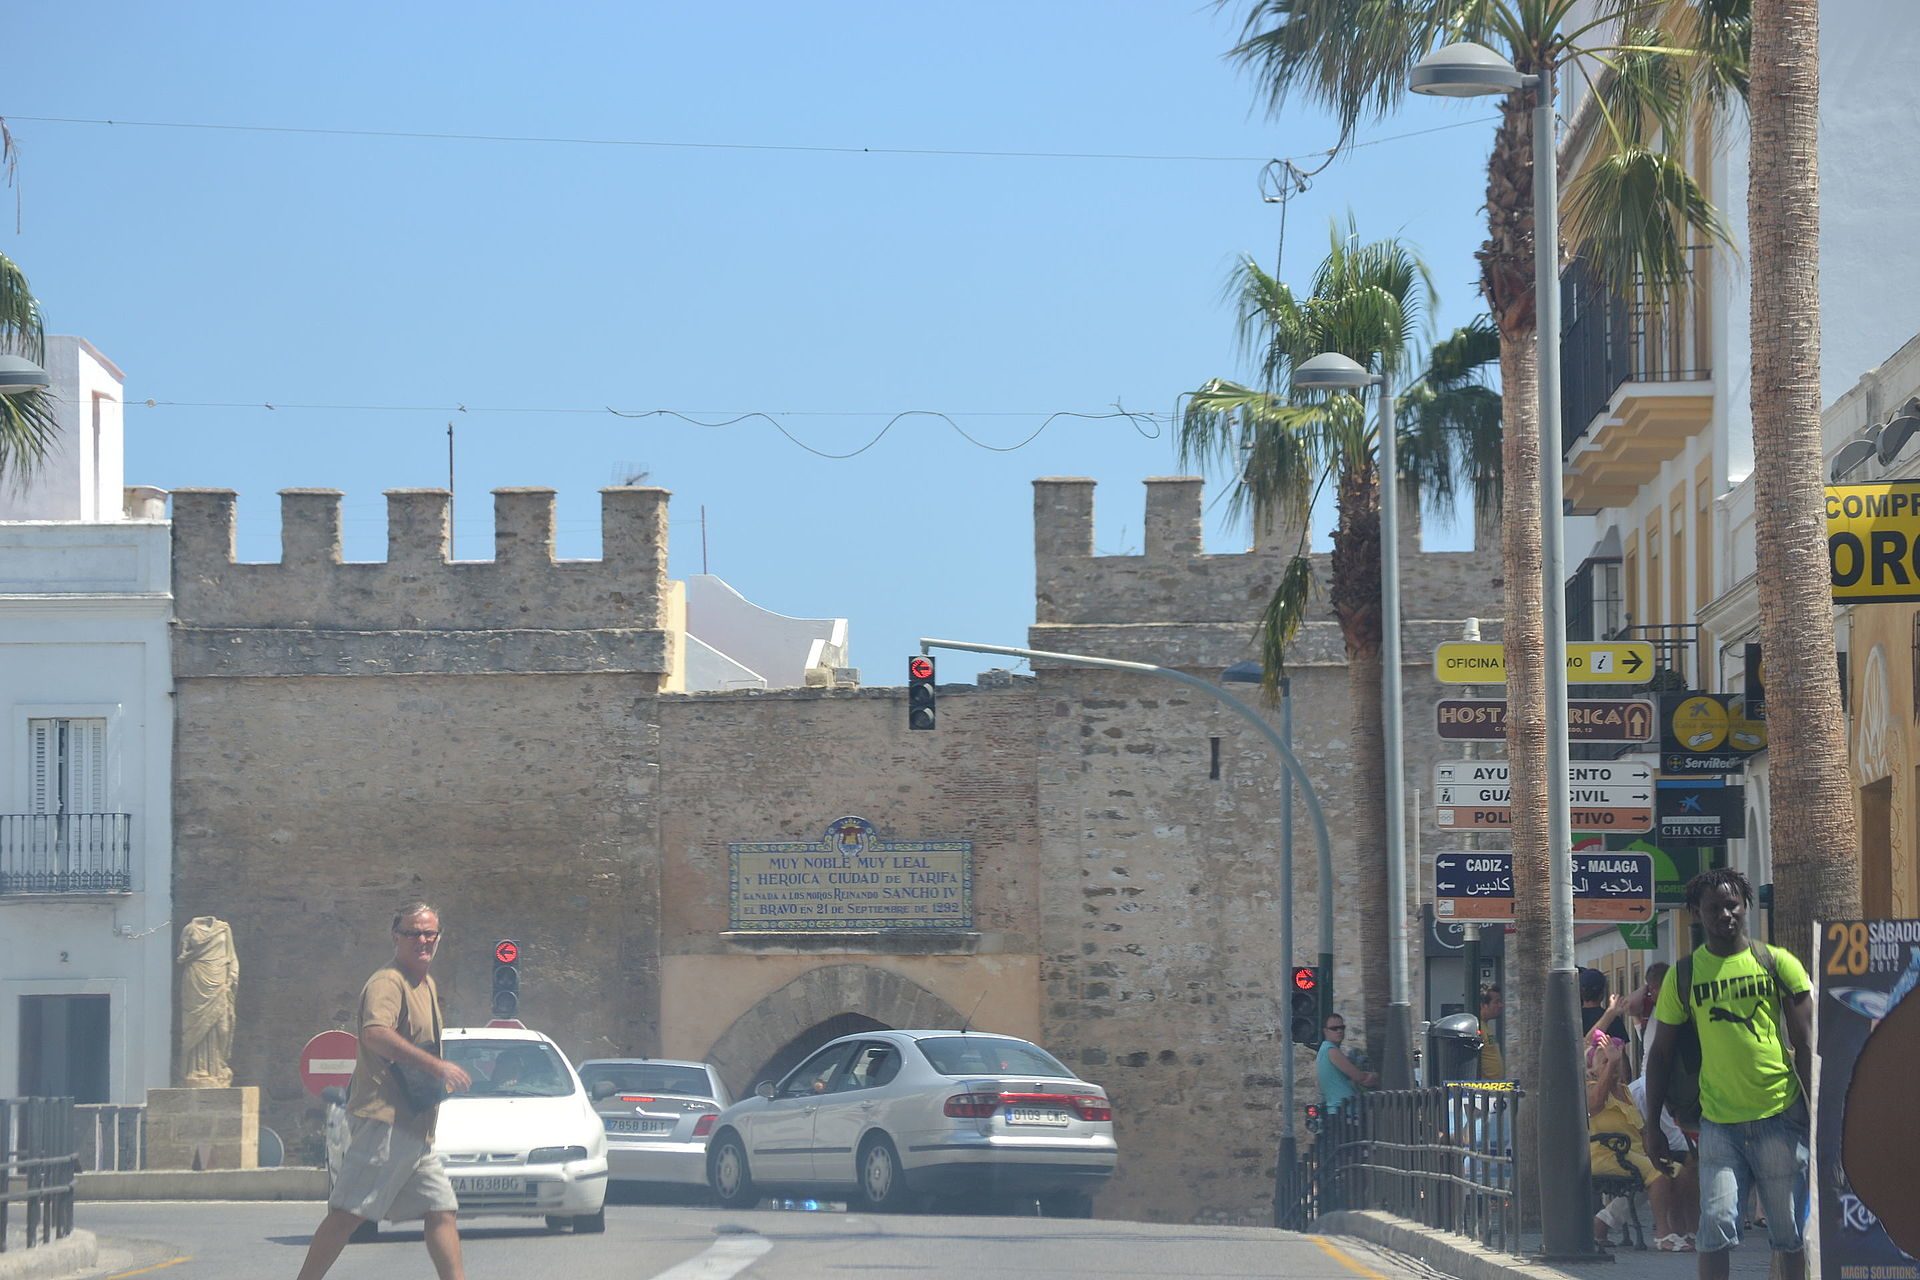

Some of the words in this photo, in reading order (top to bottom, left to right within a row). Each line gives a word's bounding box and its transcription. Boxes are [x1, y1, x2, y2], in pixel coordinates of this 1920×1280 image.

[1829, 531, 1920, 587] OR
[1446, 658, 1499, 669] OFICINA
[1440, 707, 1507, 724] HOST
[1568, 708, 1622, 725] RICA
[1474, 768, 1612, 780] AYUENTO
[1662, 825, 1721, 835] CHANGE
[769, 858, 799, 869] MUY
[804, 857, 851, 869] NOBLE
[858, 857, 887, 868] MUY
[893, 856, 931, 868] LEAL
[1465, 859, 1502, 872] CADIZ
[1588, 860, 1639, 873] MALAGA
[744, 876, 752, 885] Y
[758, 873, 820, 886] HEROICA
[828, 872, 879, 884] CIUDAD
[885, 875, 901, 884] DE
[908, 871, 959, 885] TARIFA
[789, 891, 805, 900] LOS
[806, 891, 833, 901] MOROS
[882, 887, 939, 899] SANCHO
[943, 887, 959, 899] IV
[744, 906, 757, 915] EL
[760, 903, 798, 916] BRAVO
[800, 906, 814, 914] EN
[816, 903, 828, 914] 21
[831, 905, 845, 914] DE
[914, 904, 929, 914] DE
[1869, 919, 1920, 943] SÁBADO
[1827, 922, 1870, 976] 28
[1870, 943, 1900, 961] JULIO
[60, 951, 69, 963] 2
[1869, 960, 1899, 974] 2012
[1014, 1109, 1040, 1121] 0109
[1841, 1266, 1869, 1280] MAGIC
